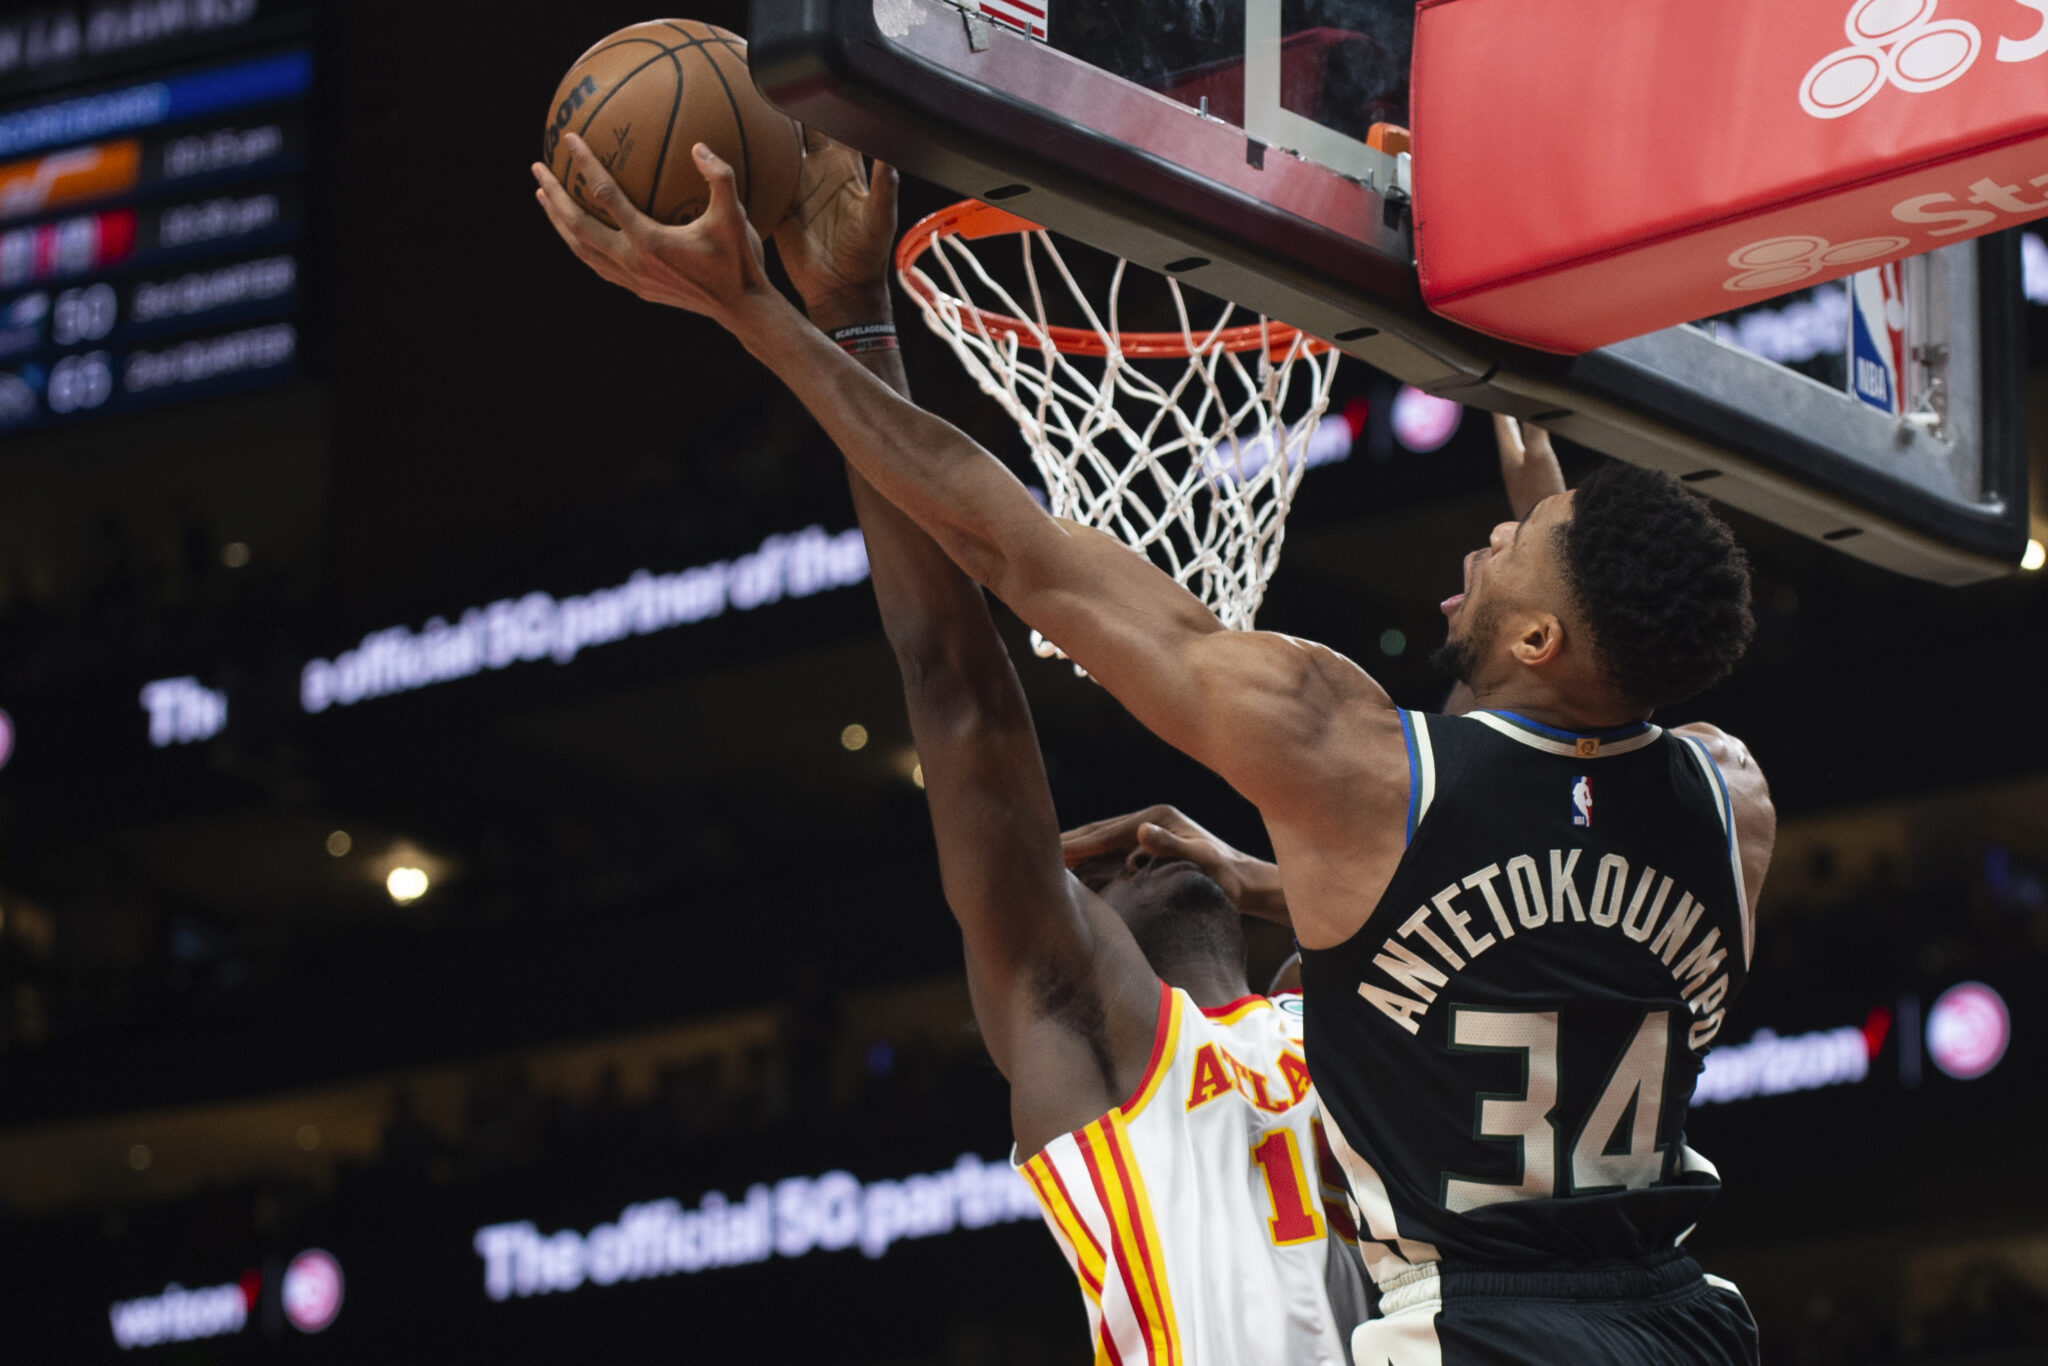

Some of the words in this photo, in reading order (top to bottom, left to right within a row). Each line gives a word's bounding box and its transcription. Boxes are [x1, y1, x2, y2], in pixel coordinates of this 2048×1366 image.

[1856, 355, 1888, 402] NBA
[728, 534, 790, 611] of
[1357, 848, 1729, 1051] ANTETOKOUNMPO
[1186, 1040, 1313, 1115] ATLA
[1440, 1002, 1673, 1216] 34
[474, 1219, 586, 1301] The
[584, 1182, 772, 1287] official
[859, 1151, 1048, 1259] partn
[109, 1281, 248, 1350] verizon
